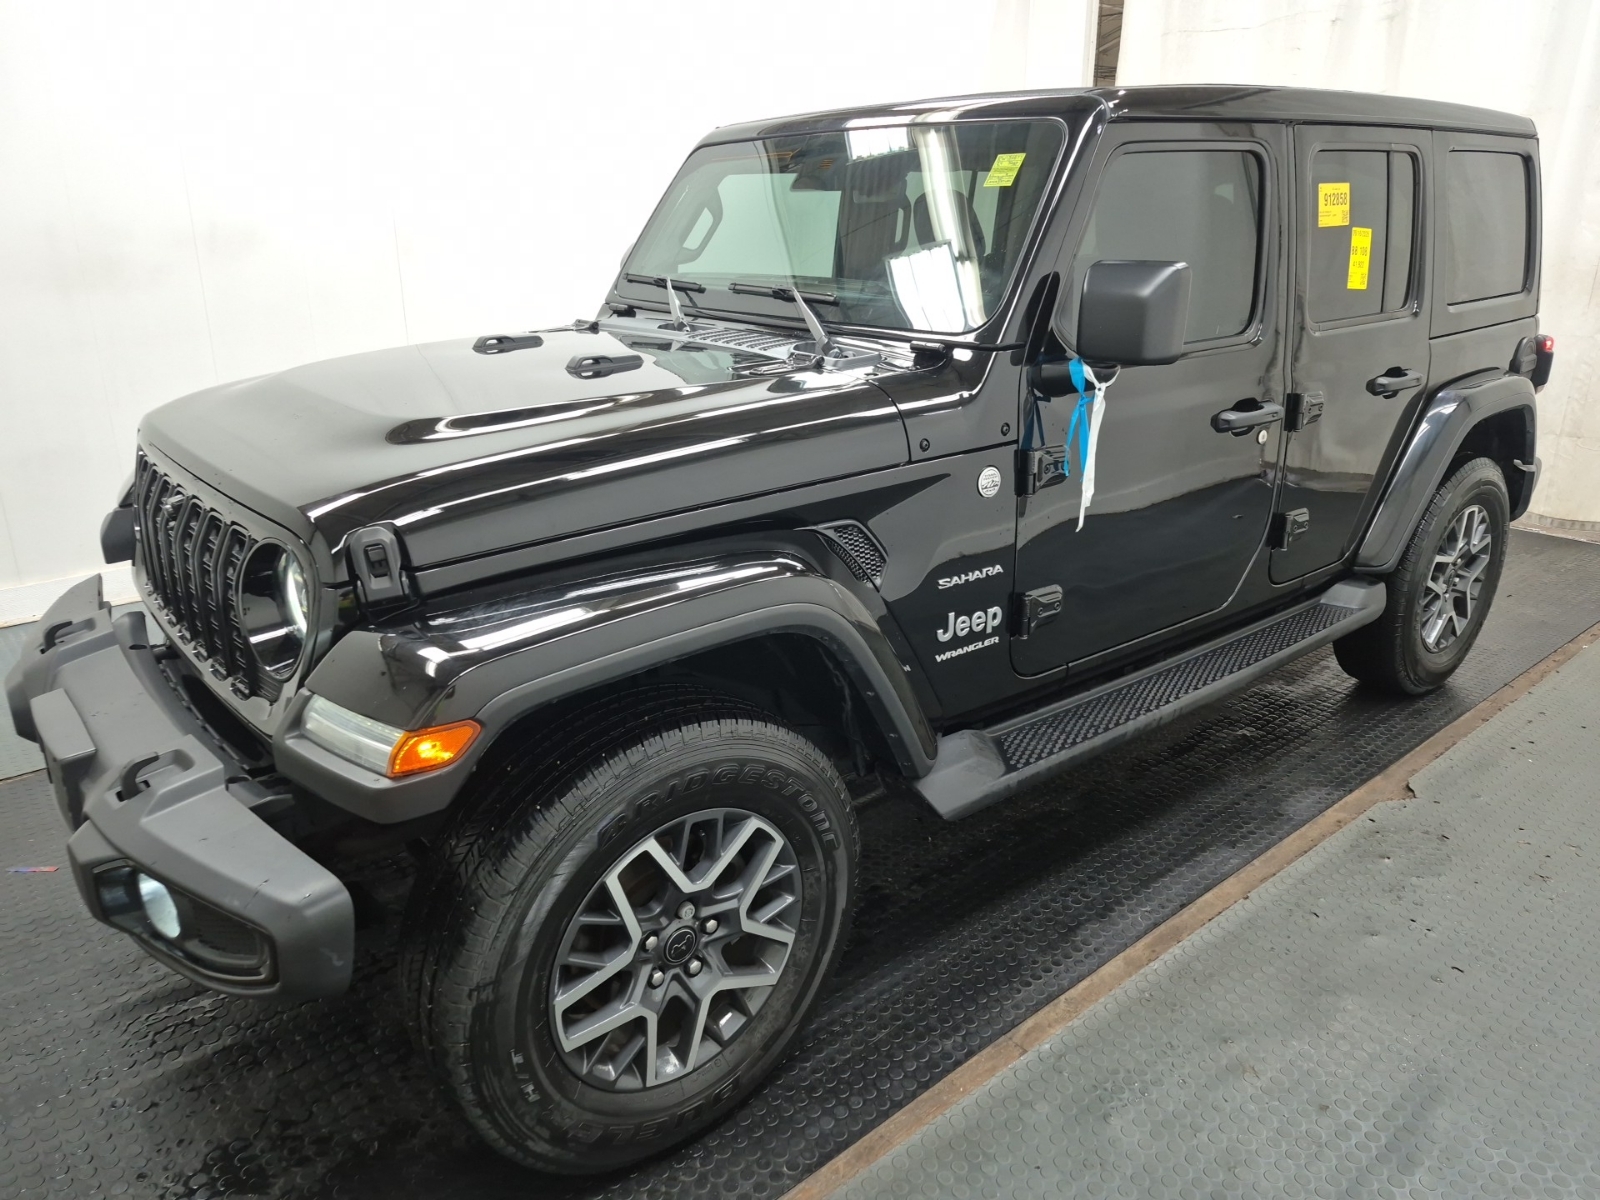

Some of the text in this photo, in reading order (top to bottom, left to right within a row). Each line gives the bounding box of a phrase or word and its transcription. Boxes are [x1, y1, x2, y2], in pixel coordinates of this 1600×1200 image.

[1324, 192, 1348, 206] 912858
[937, 564, 1004, 589] SAHARA
[936, 606, 1003, 642] Jeep
[935, 636, 1000, 662] WRANGLER
